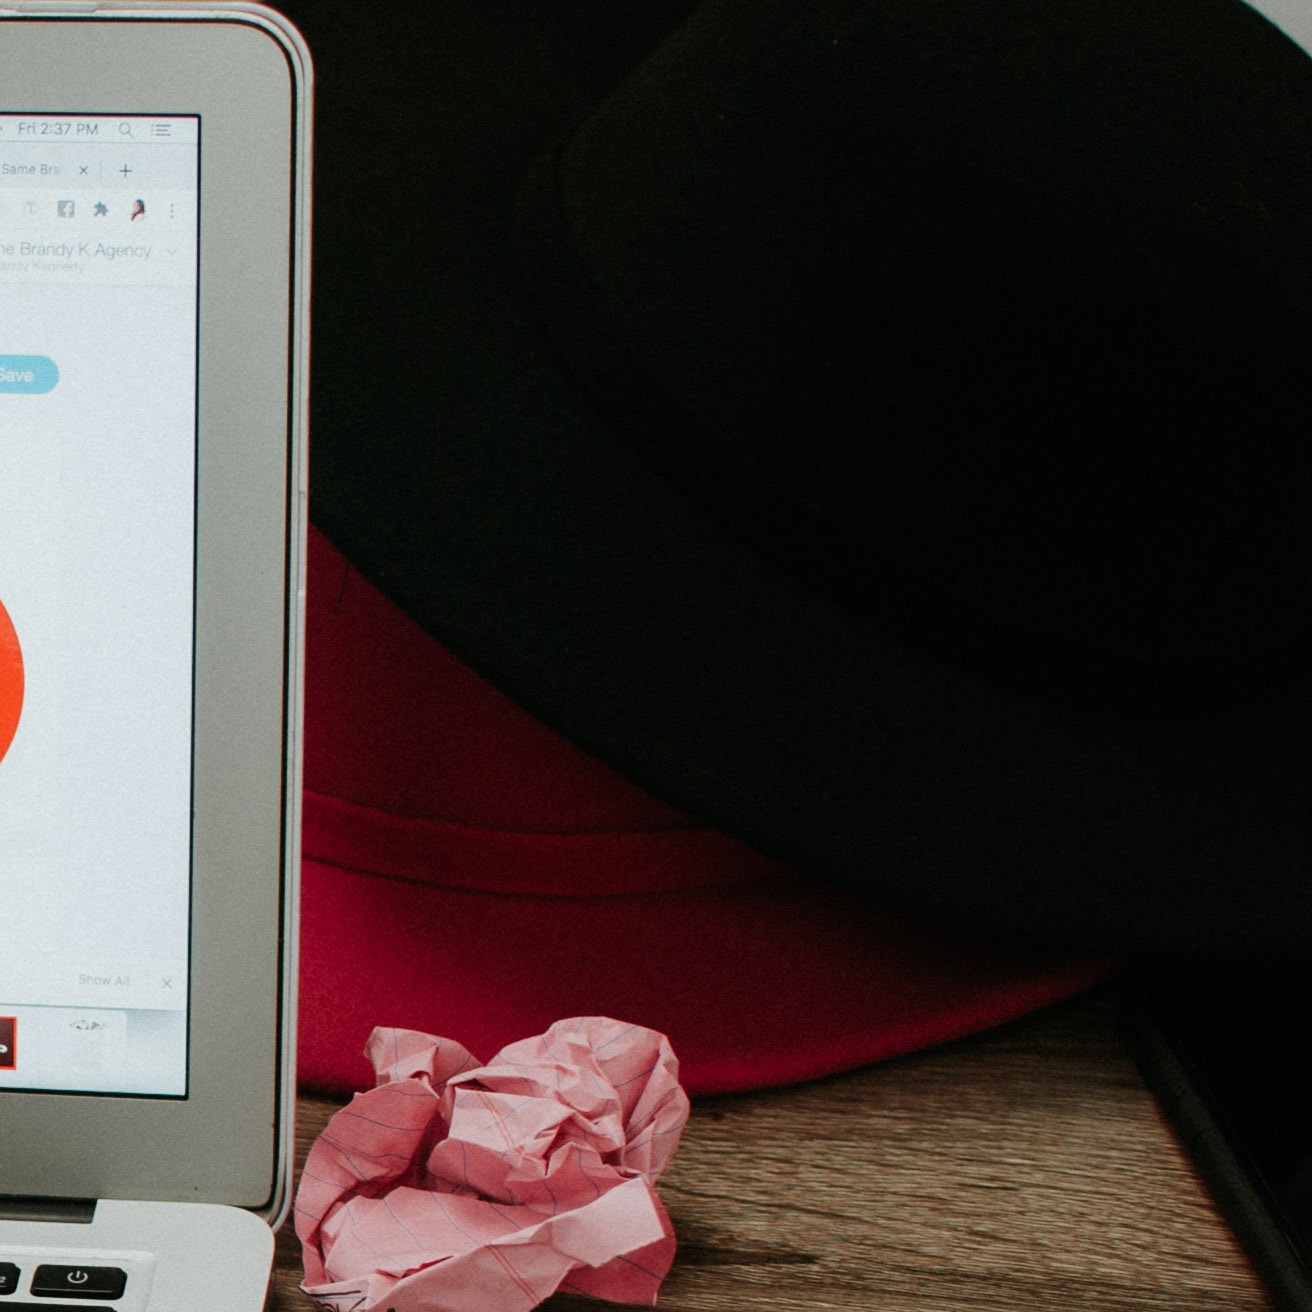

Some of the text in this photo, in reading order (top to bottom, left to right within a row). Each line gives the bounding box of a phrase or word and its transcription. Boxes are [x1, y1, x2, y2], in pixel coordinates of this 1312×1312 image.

[18, 122, 37, 135] Fri
[41, 122, 71, 135] 2:37
[77, 123, 98, 136] PM
[20, 242, 73, 259] Brandy
[78, 242, 91, 256] K
[94, 243, 151, 261] Agency
